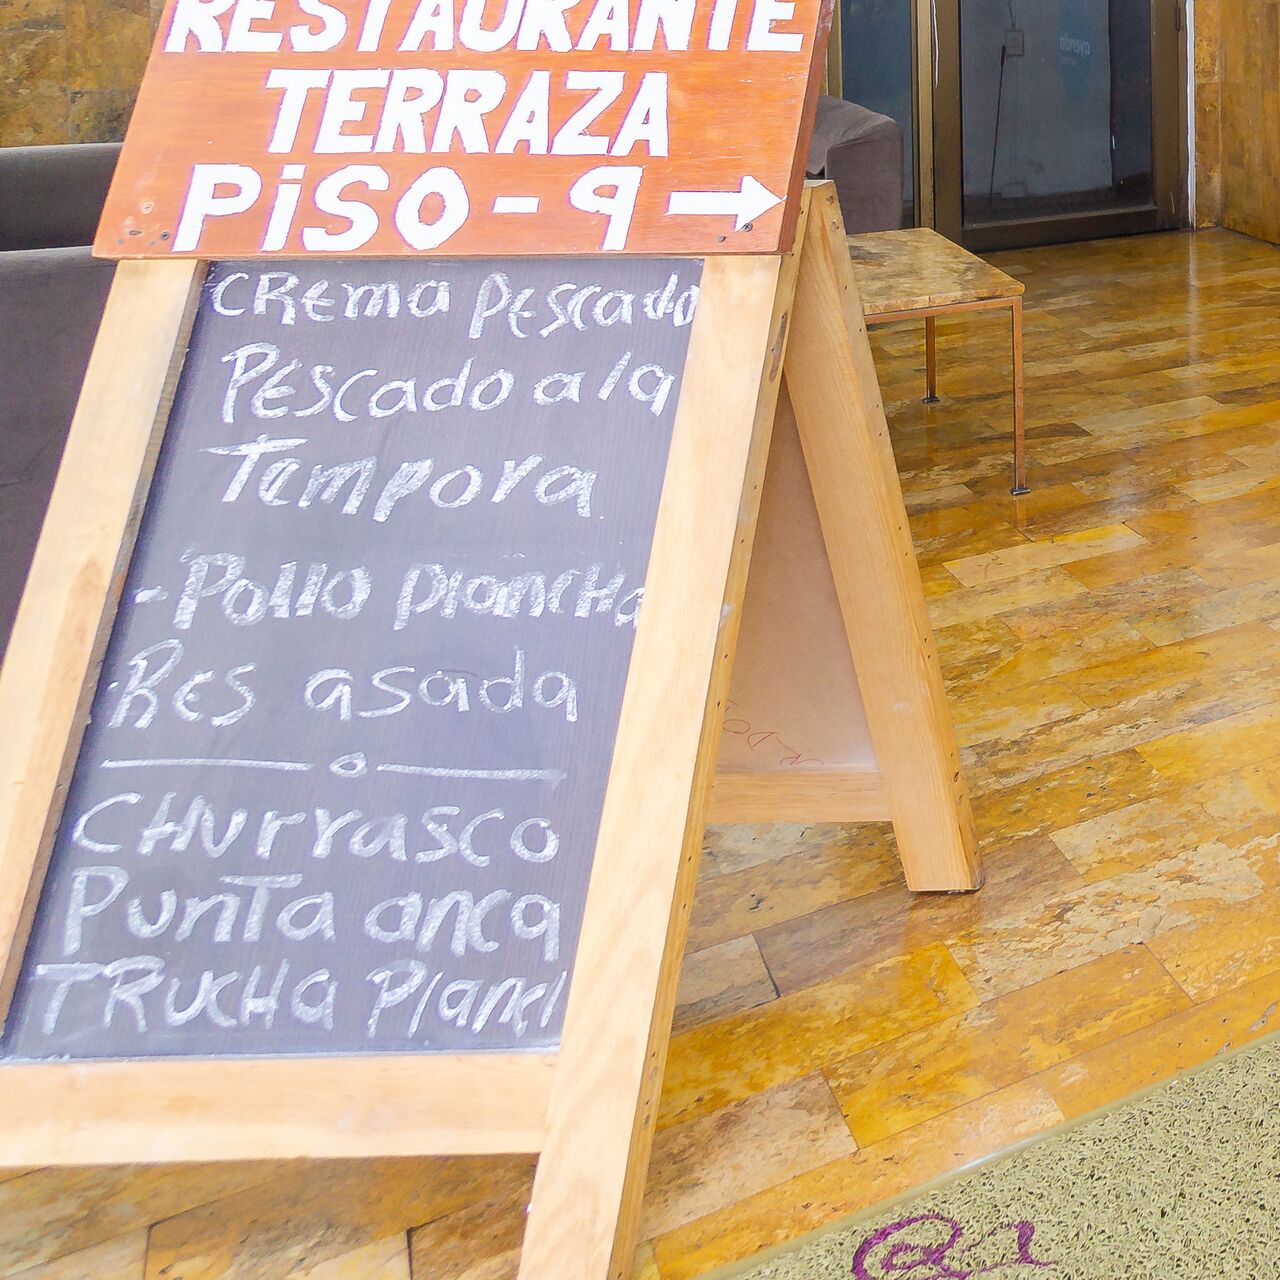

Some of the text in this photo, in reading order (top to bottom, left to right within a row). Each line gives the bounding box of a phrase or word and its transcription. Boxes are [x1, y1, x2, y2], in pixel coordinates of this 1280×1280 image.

[266, 70, 669, 157] TERRAZA
[304, 644, 579, 723] asada
[364, 888, 562, 963] anca
